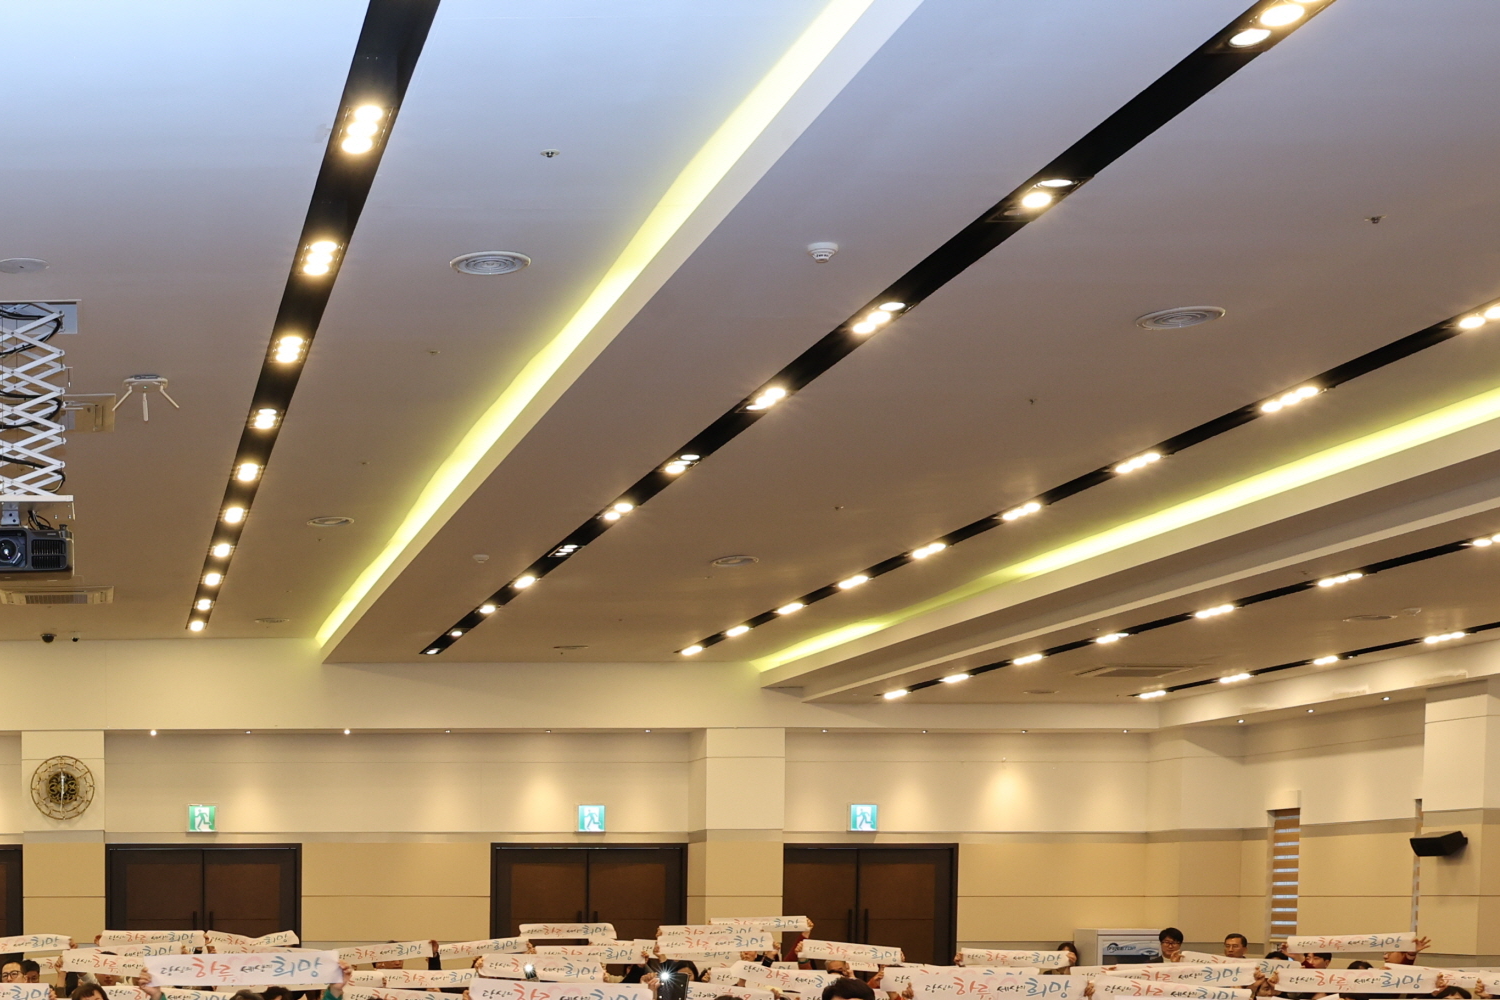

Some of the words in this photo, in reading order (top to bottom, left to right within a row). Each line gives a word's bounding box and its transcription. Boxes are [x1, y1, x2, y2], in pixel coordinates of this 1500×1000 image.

[168, 932, 195, 944] 희망
[733, 936, 766, 948] 희망
[1368, 936, 1402, 948] 희망
[396, 944, 422, 956] 희망
[605, 948, 634, 960] 희망
[870, 948, 898, 962] 희망
[1031, 952, 1062, 965] 희망
[160, 965, 193, 976] 당신의
[192, 956, 236, 983] 하루,
[239, 963, 273, 973] 세상의
[271, 956, 323, 978] 희망
[563, 963, 598, 980] 희망
[1201, 966, 1242, 982] 희망
[1289, 976, 1314, 984] 당신의
[1380, 972, 1424, 989] 희망
[925, 984, 953, 993] 당신의
[996, 985, 1026, 993] 세상의
[1025, 977, 1072, 998] 희망
[1104, 985, 1132, 993] 당신의
[1170, 990, 1197, 998] 세상의
[482, 990, 513, 1000] 당신의
